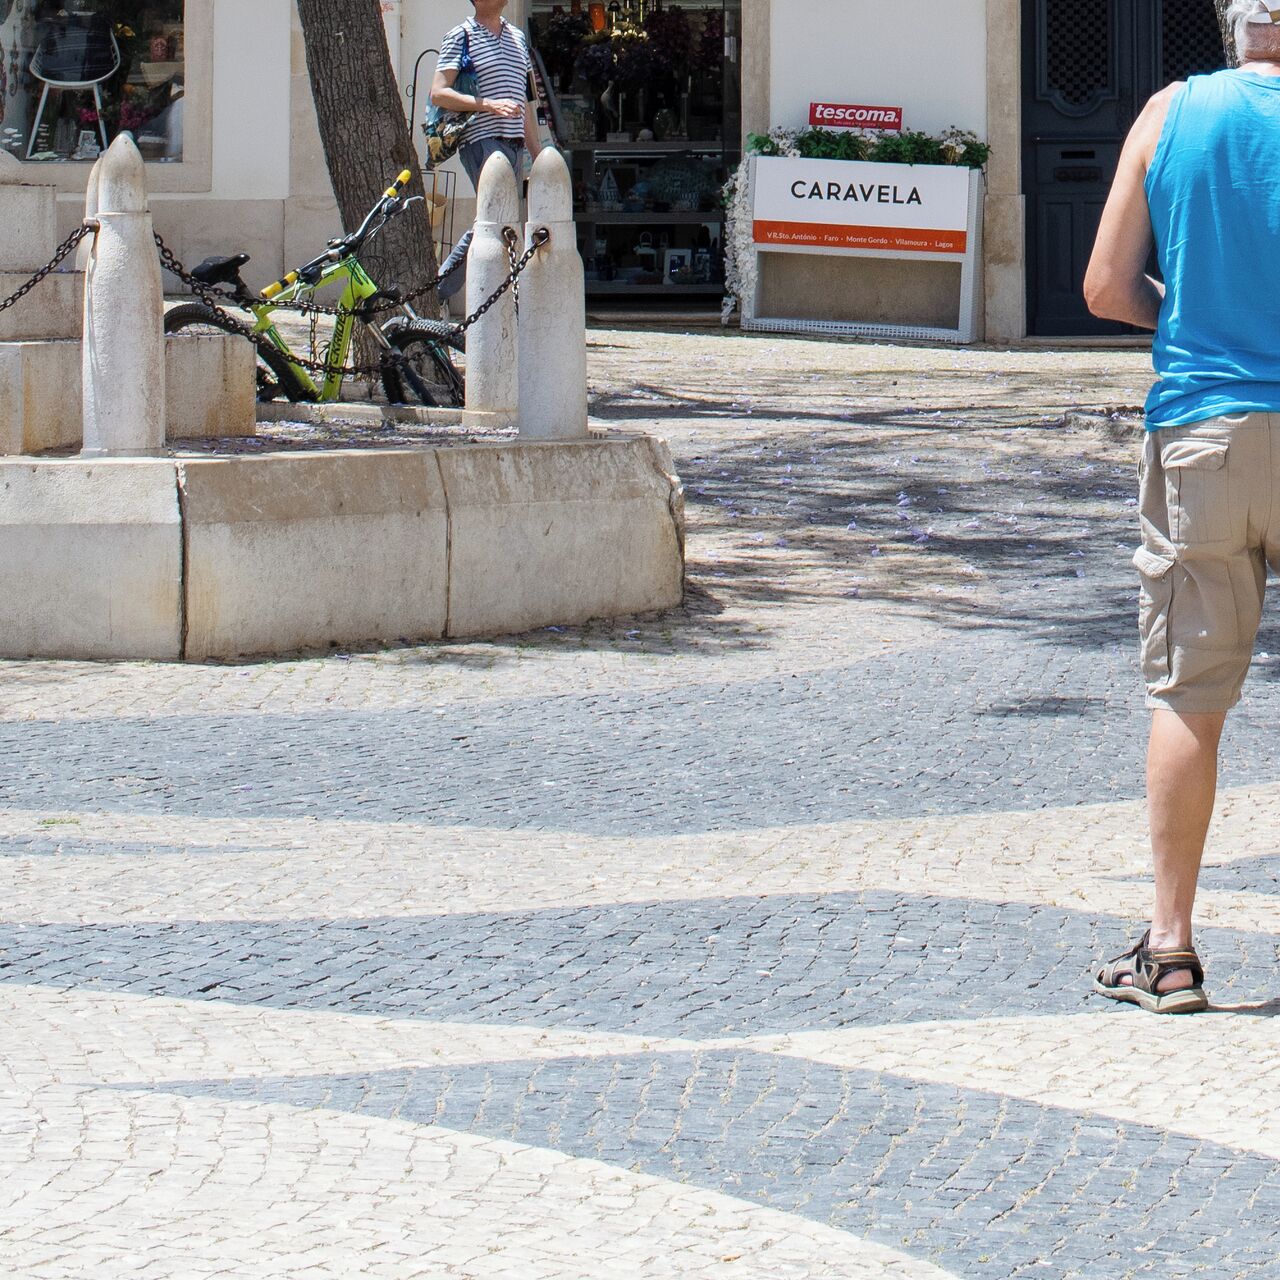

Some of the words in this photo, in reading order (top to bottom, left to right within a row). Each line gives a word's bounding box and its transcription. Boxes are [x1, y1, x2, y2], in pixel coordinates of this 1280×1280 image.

[791, 180, 923, 205] CARAVELA
[791, 233, 817, 241] António
[824, 234, 839, 242] Faro
[846, 235, 867, 243] Monte
[867, 237, 888, 245] Gordo
[895, 238, 928, 247] Vilamoura
[935, 241, 953, 249] Lagos
